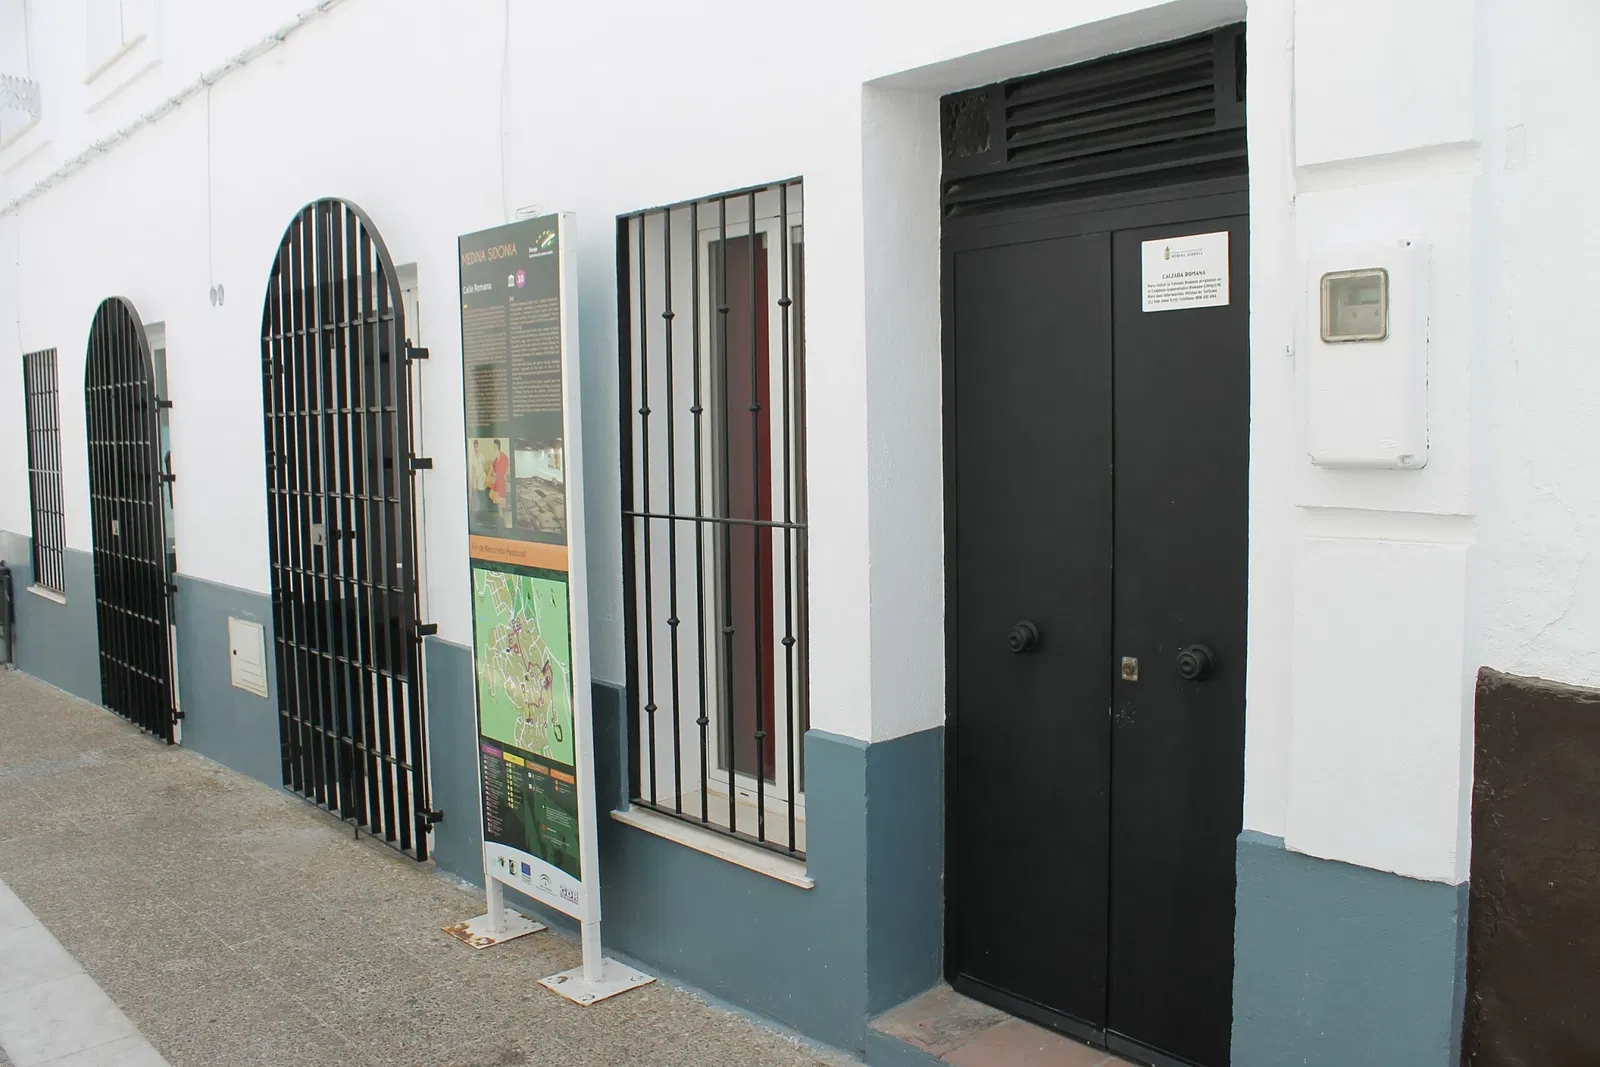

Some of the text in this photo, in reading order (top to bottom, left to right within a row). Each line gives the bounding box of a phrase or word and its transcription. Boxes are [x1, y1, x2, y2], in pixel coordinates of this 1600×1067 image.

[462, 250, 486, 266] MEDINA
[488, 242, 517, 260] SIDONIA
[474, 283, 492, 292] Romana
